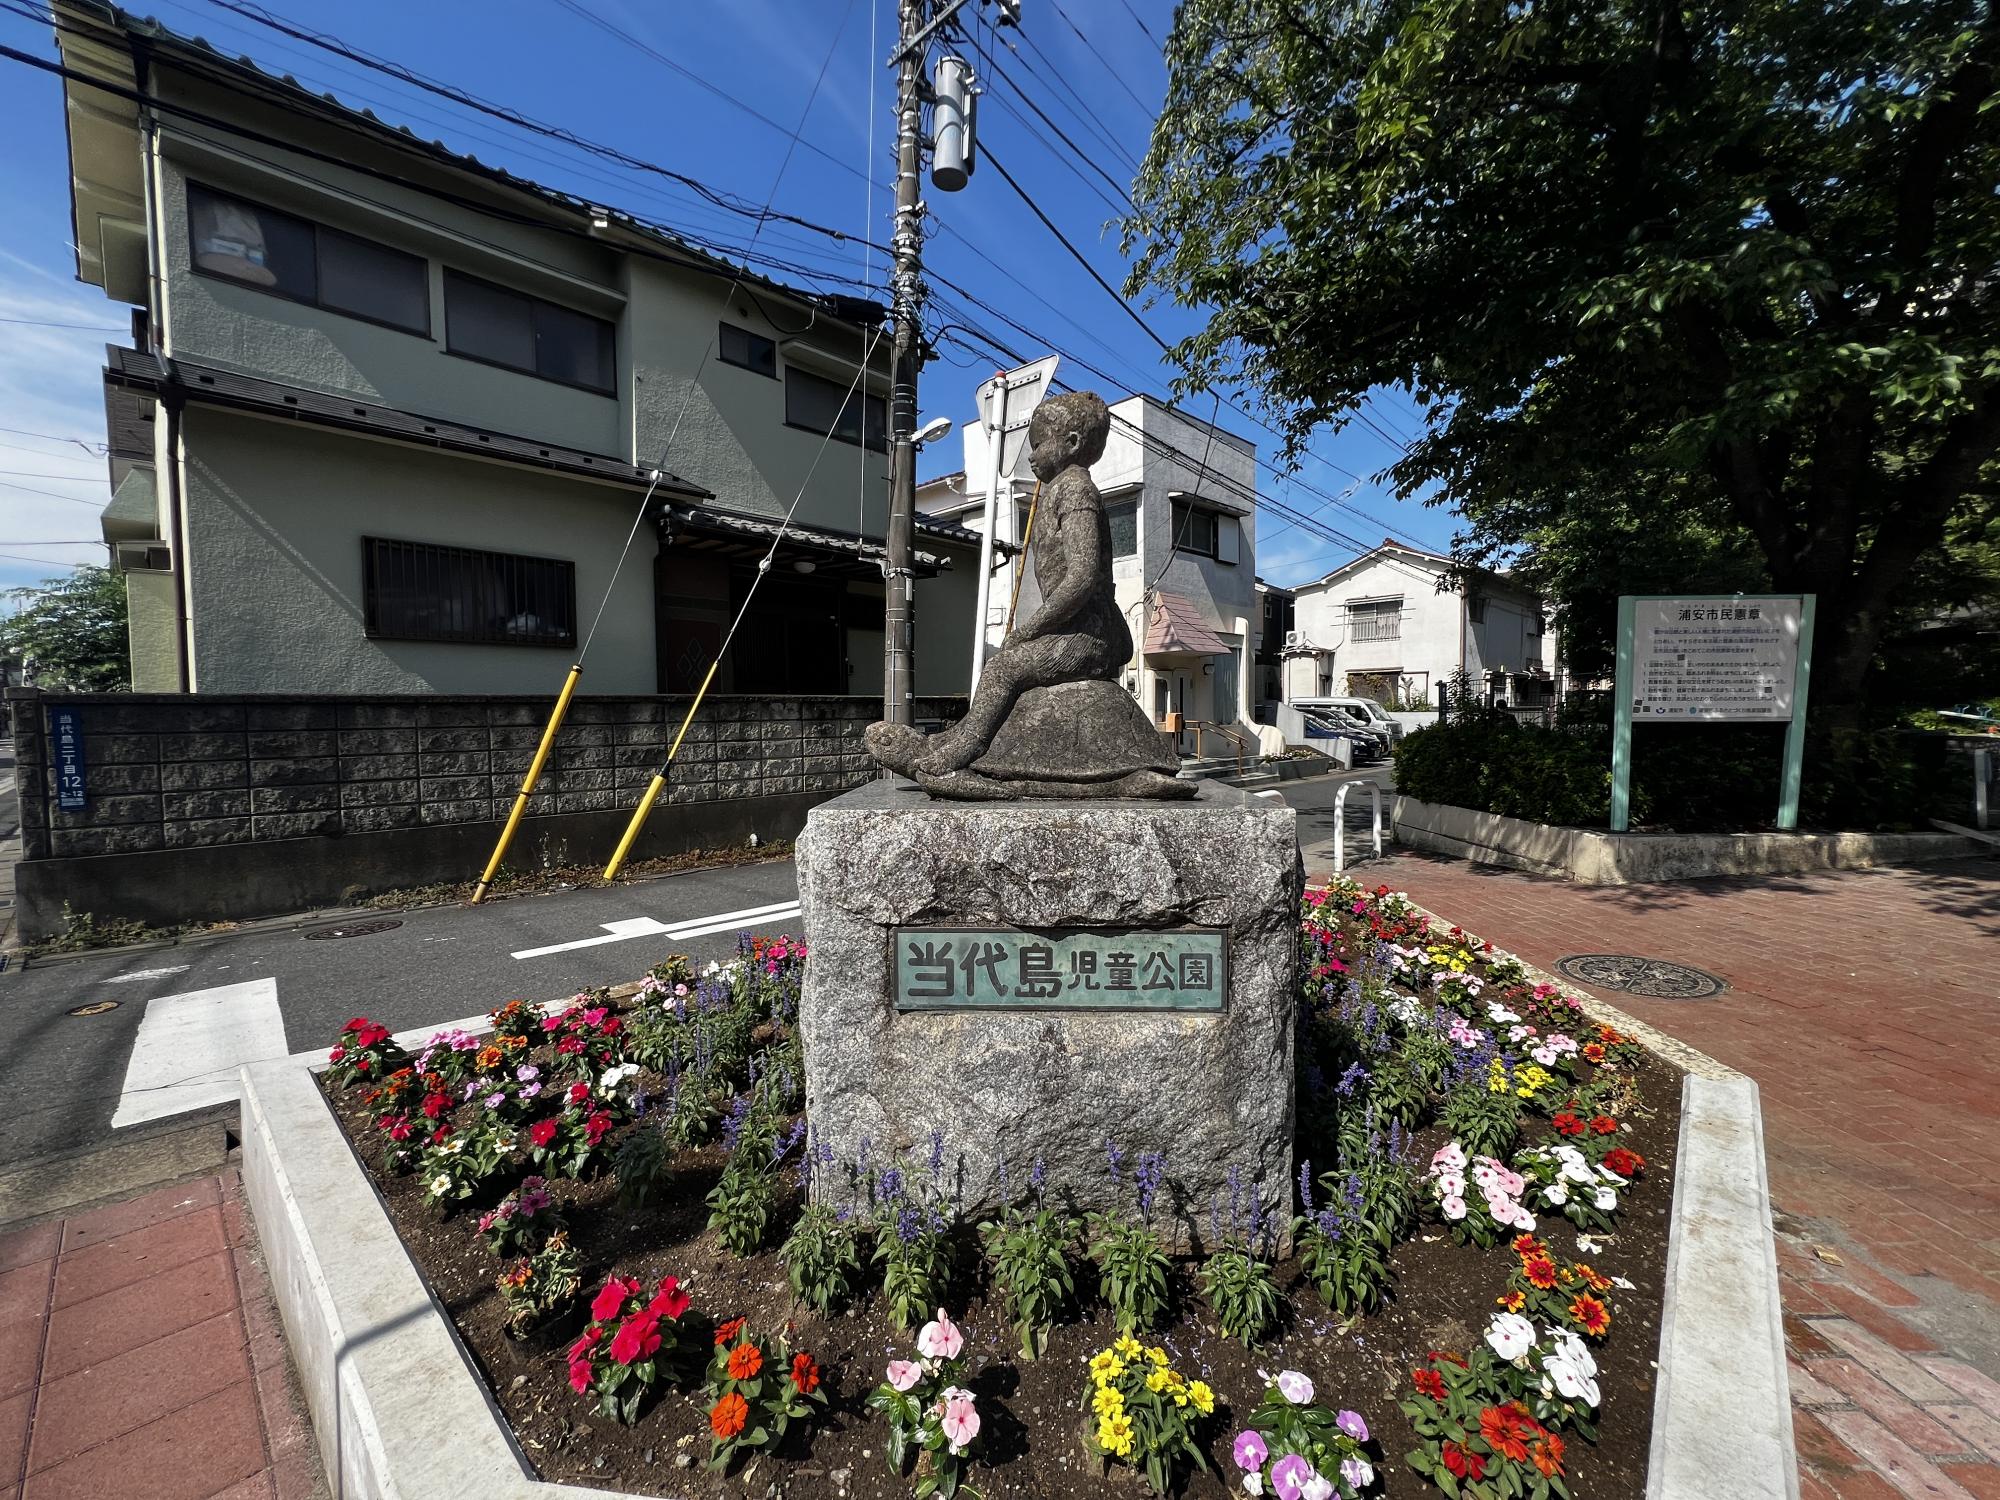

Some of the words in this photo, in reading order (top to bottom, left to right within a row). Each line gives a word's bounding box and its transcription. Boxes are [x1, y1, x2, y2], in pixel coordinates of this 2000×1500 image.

[1678, 608, 1761, 621] 浦安市民憲章
[59, 714, 76, 774] 当代島二丁目
[62, 776, 82, 788] 12
[907, 941, 1213, 998] 当代島児童公園
